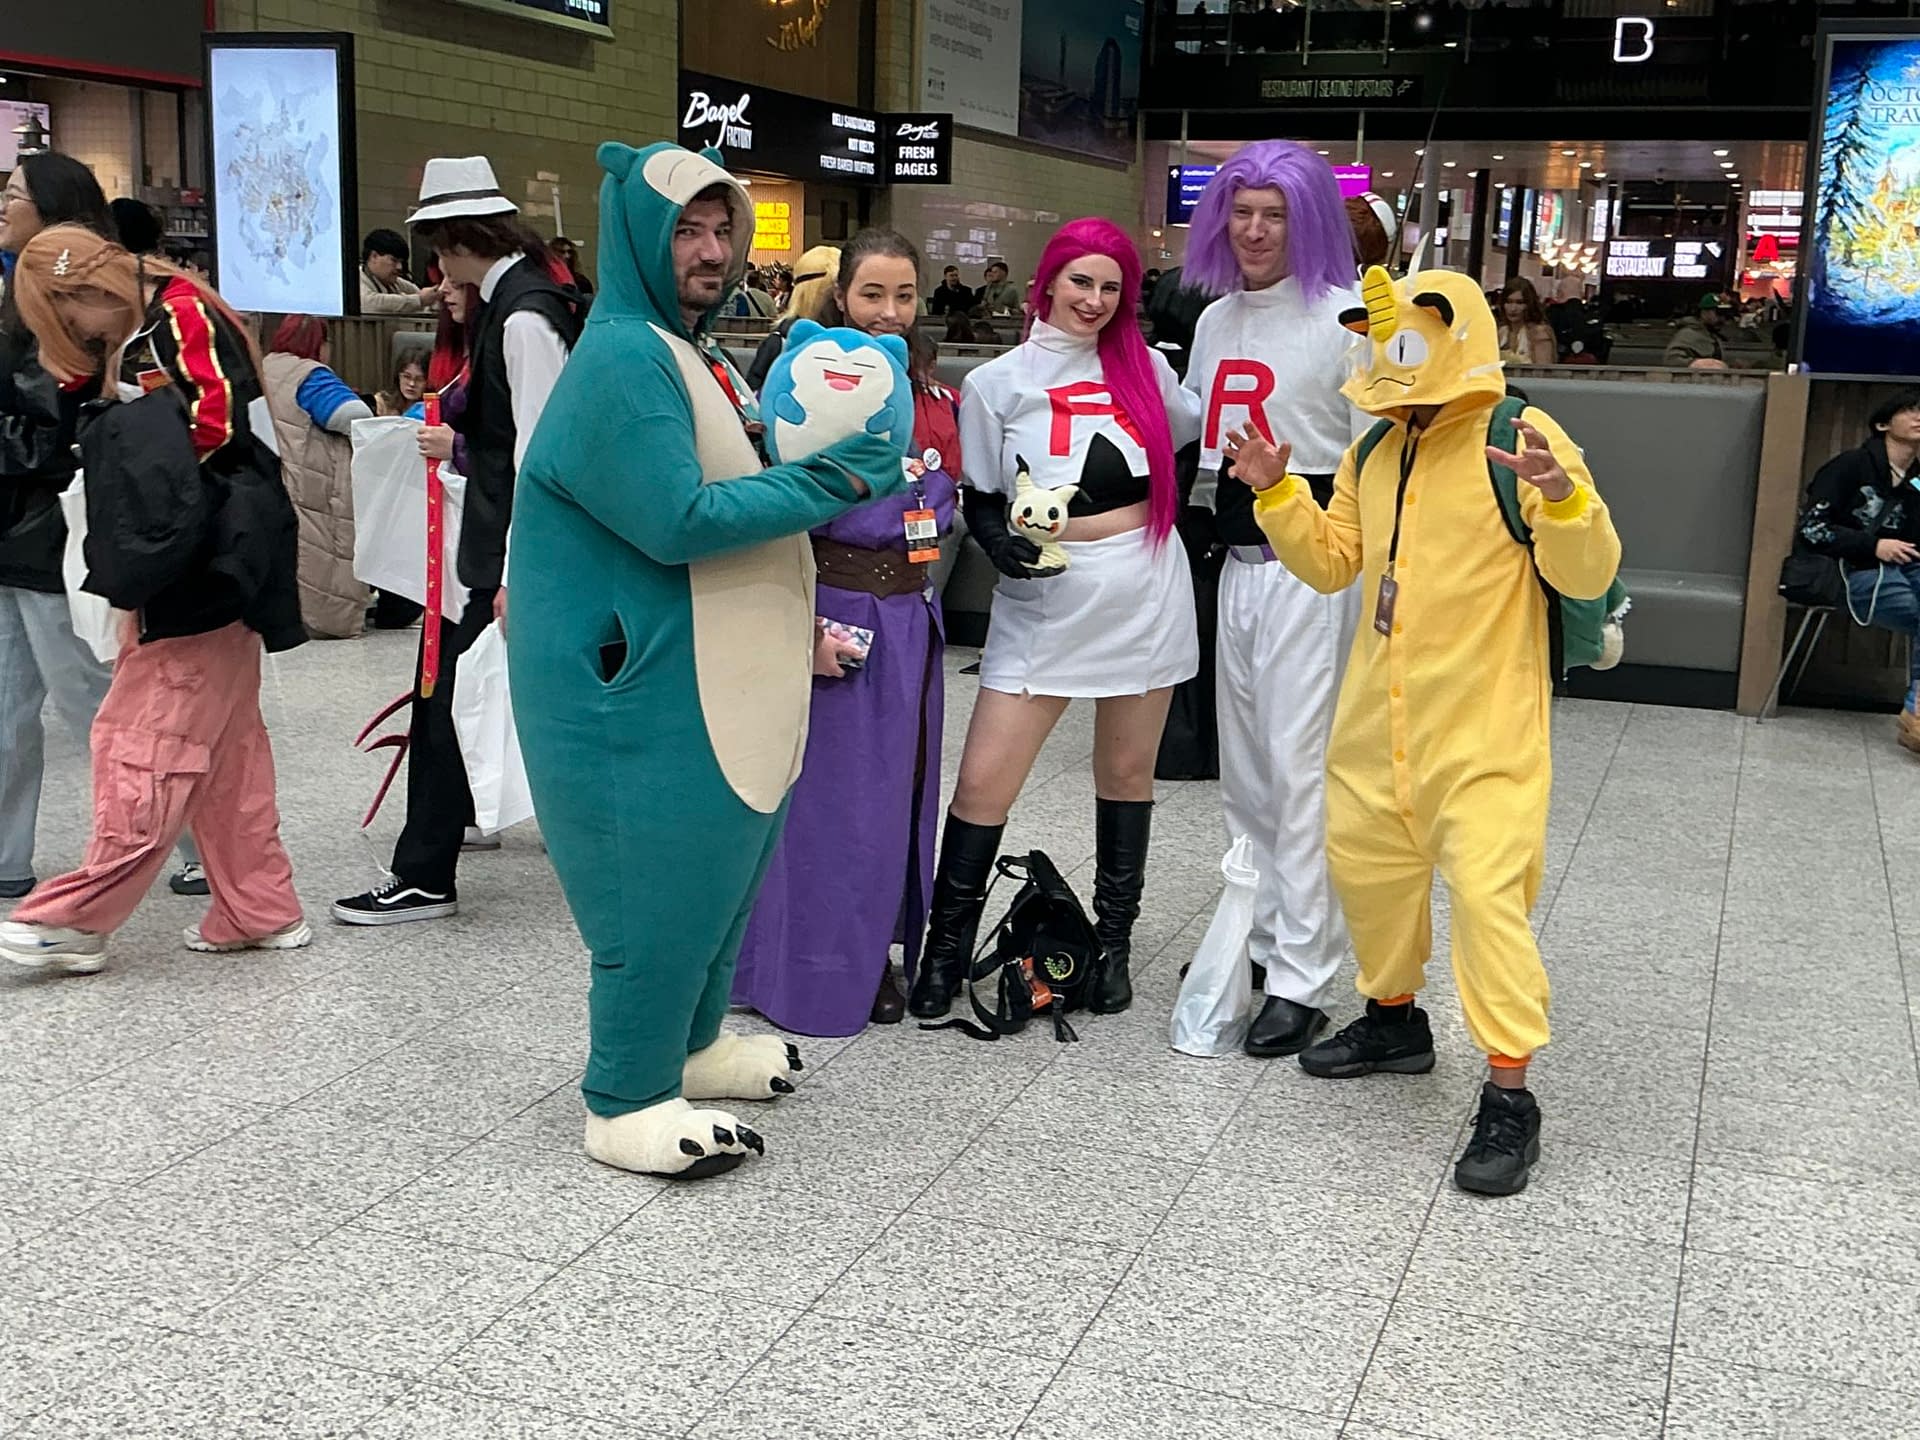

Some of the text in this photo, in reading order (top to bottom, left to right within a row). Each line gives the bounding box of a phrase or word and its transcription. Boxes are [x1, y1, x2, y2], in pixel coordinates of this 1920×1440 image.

[1612, 16, 1655, 63] B
[1261, 79, 1394, 98] RESTAURANT SEATING UPSTAIRS
[1871, 86, 1920, 103] OCT
[682, 91, 752, 148] Bagel
[726, 125, 753, 150] FACTORY
[895, 120, 938, 142] Bagel
[898, 145, 935, 159] FRESH
[895, 162, 938, 177] BAGELS
[1606, 256, 1667, 277] RESTAURANT
[1204, 359, 1277, 449] R
[1045, 380, 1147, 457] R
